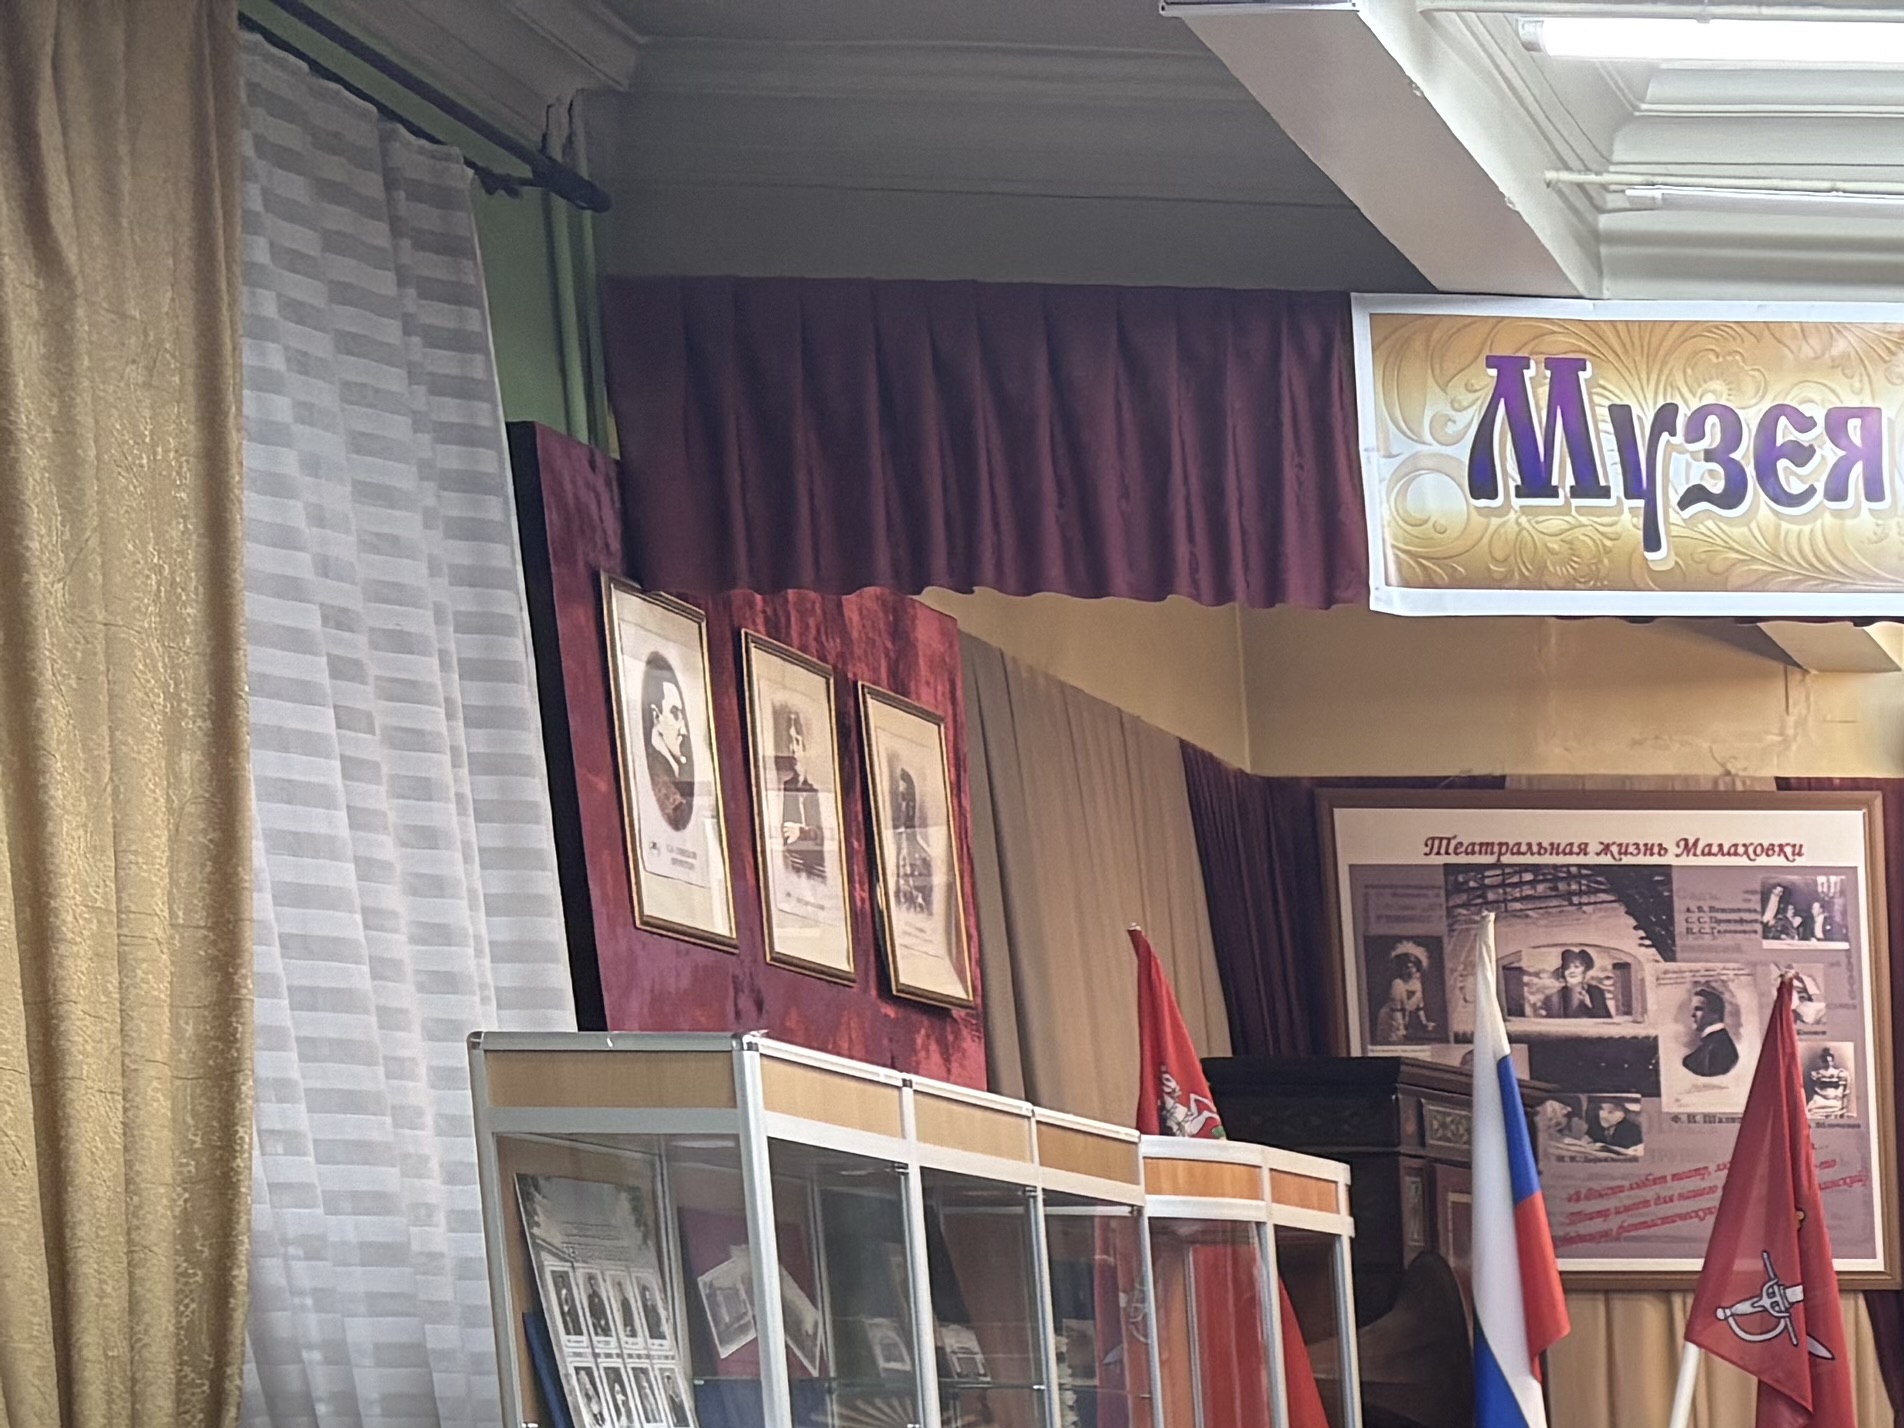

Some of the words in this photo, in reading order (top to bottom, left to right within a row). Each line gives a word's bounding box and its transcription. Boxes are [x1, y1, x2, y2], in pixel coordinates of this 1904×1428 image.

[1468, 354, 1888, 560] Музея
[1423, 836, 1589, 863] Театральная
[1595, 840, 1669, 863] жизнь
[1675, 837, 1805, 862] Малаховки
